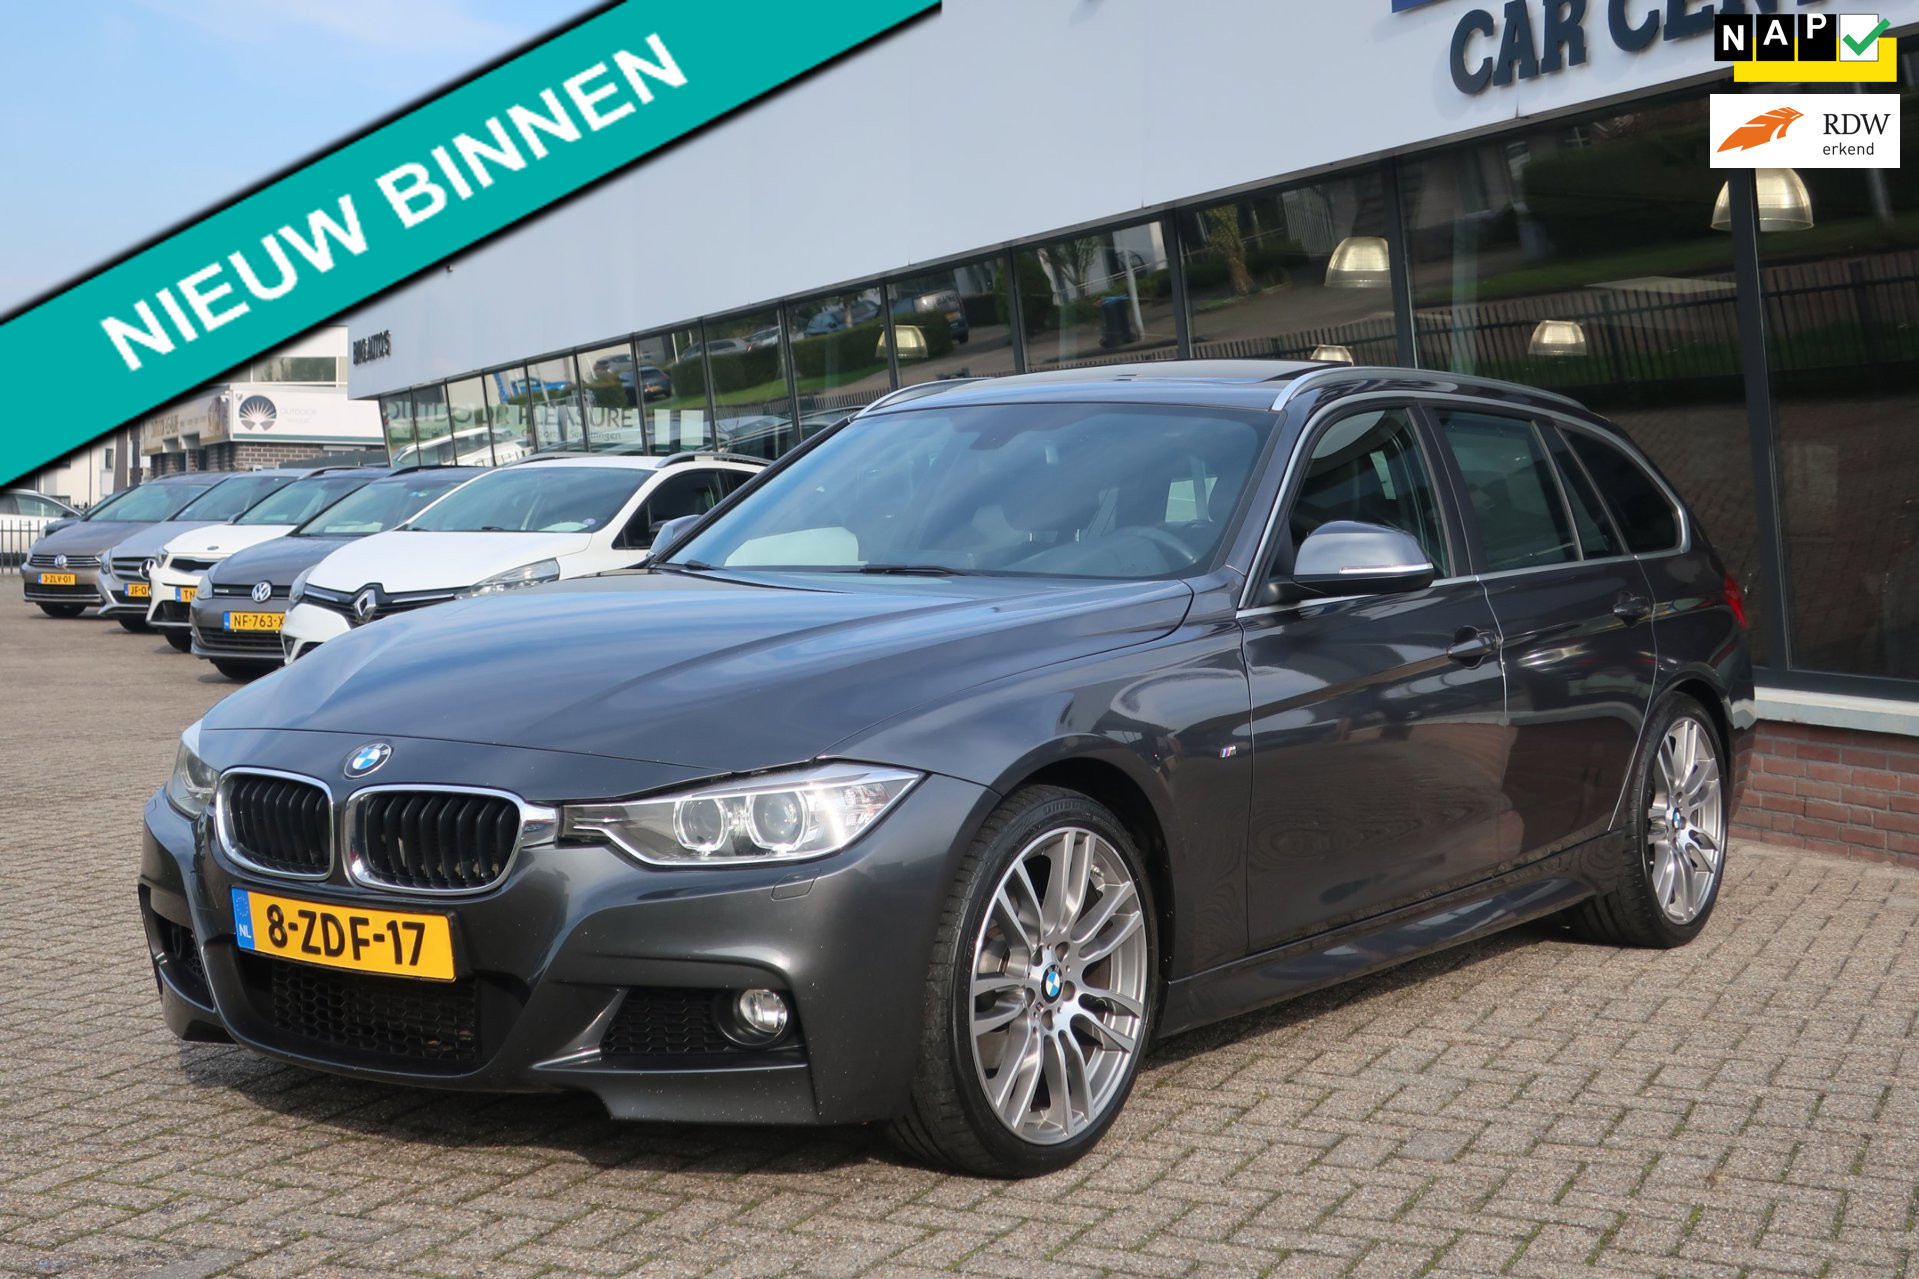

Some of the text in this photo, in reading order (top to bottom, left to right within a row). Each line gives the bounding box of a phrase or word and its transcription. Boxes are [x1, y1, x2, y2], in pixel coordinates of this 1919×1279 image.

[1450, 0, 1587, 95] CAR
[239, 923, 252, 938] NL
[266, 904, 426, 967] 8-ZDF-17
